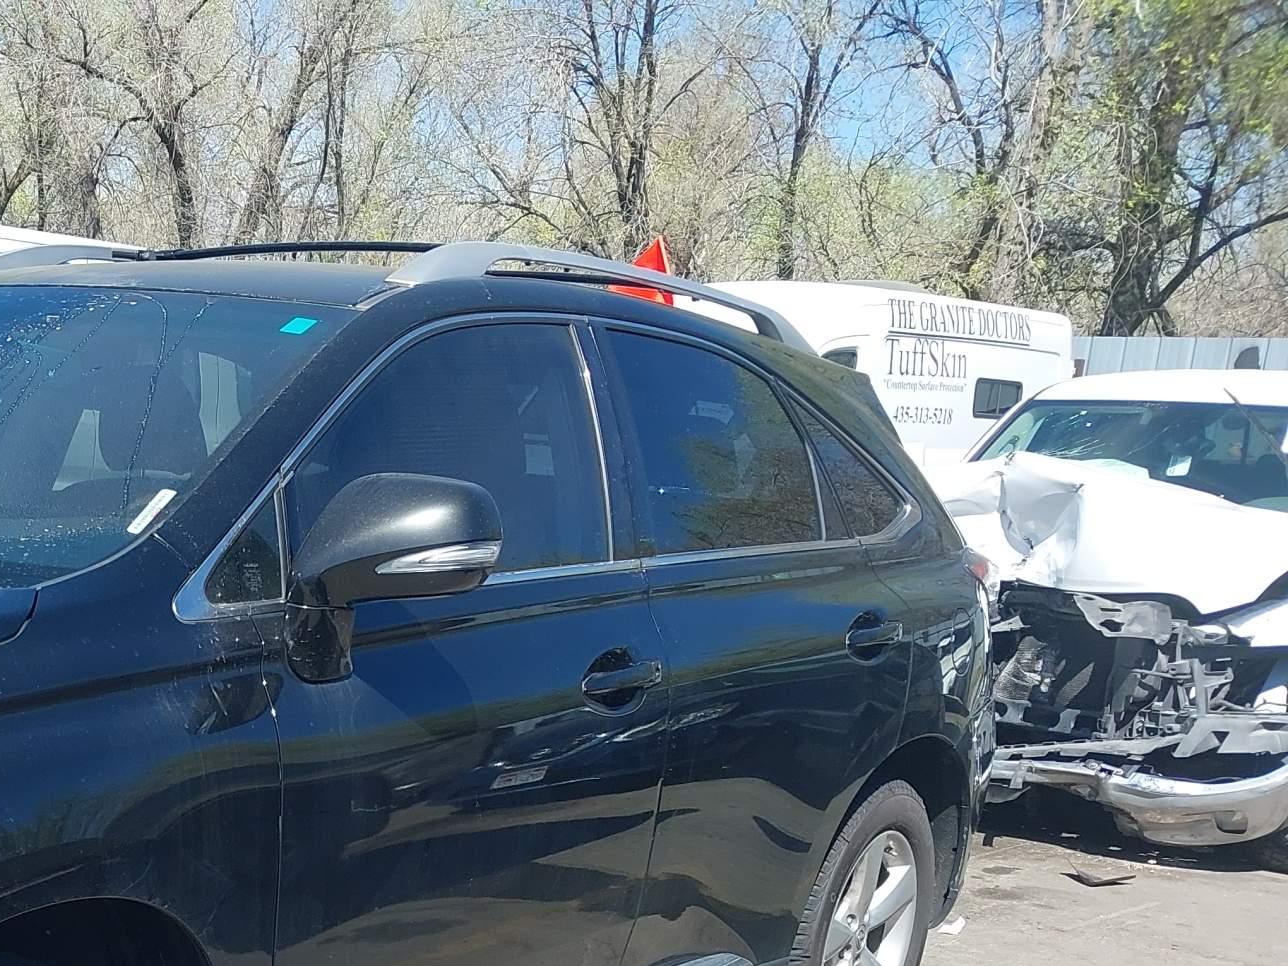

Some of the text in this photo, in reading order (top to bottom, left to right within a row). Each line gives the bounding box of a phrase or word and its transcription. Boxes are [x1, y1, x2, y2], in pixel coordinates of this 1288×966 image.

[888, 298, 1032, 342] THE GRANITE DOCTORS
[885, 337, 968, 379] TuffSkin
[893, 406, 954, 425] 435-313-5218
